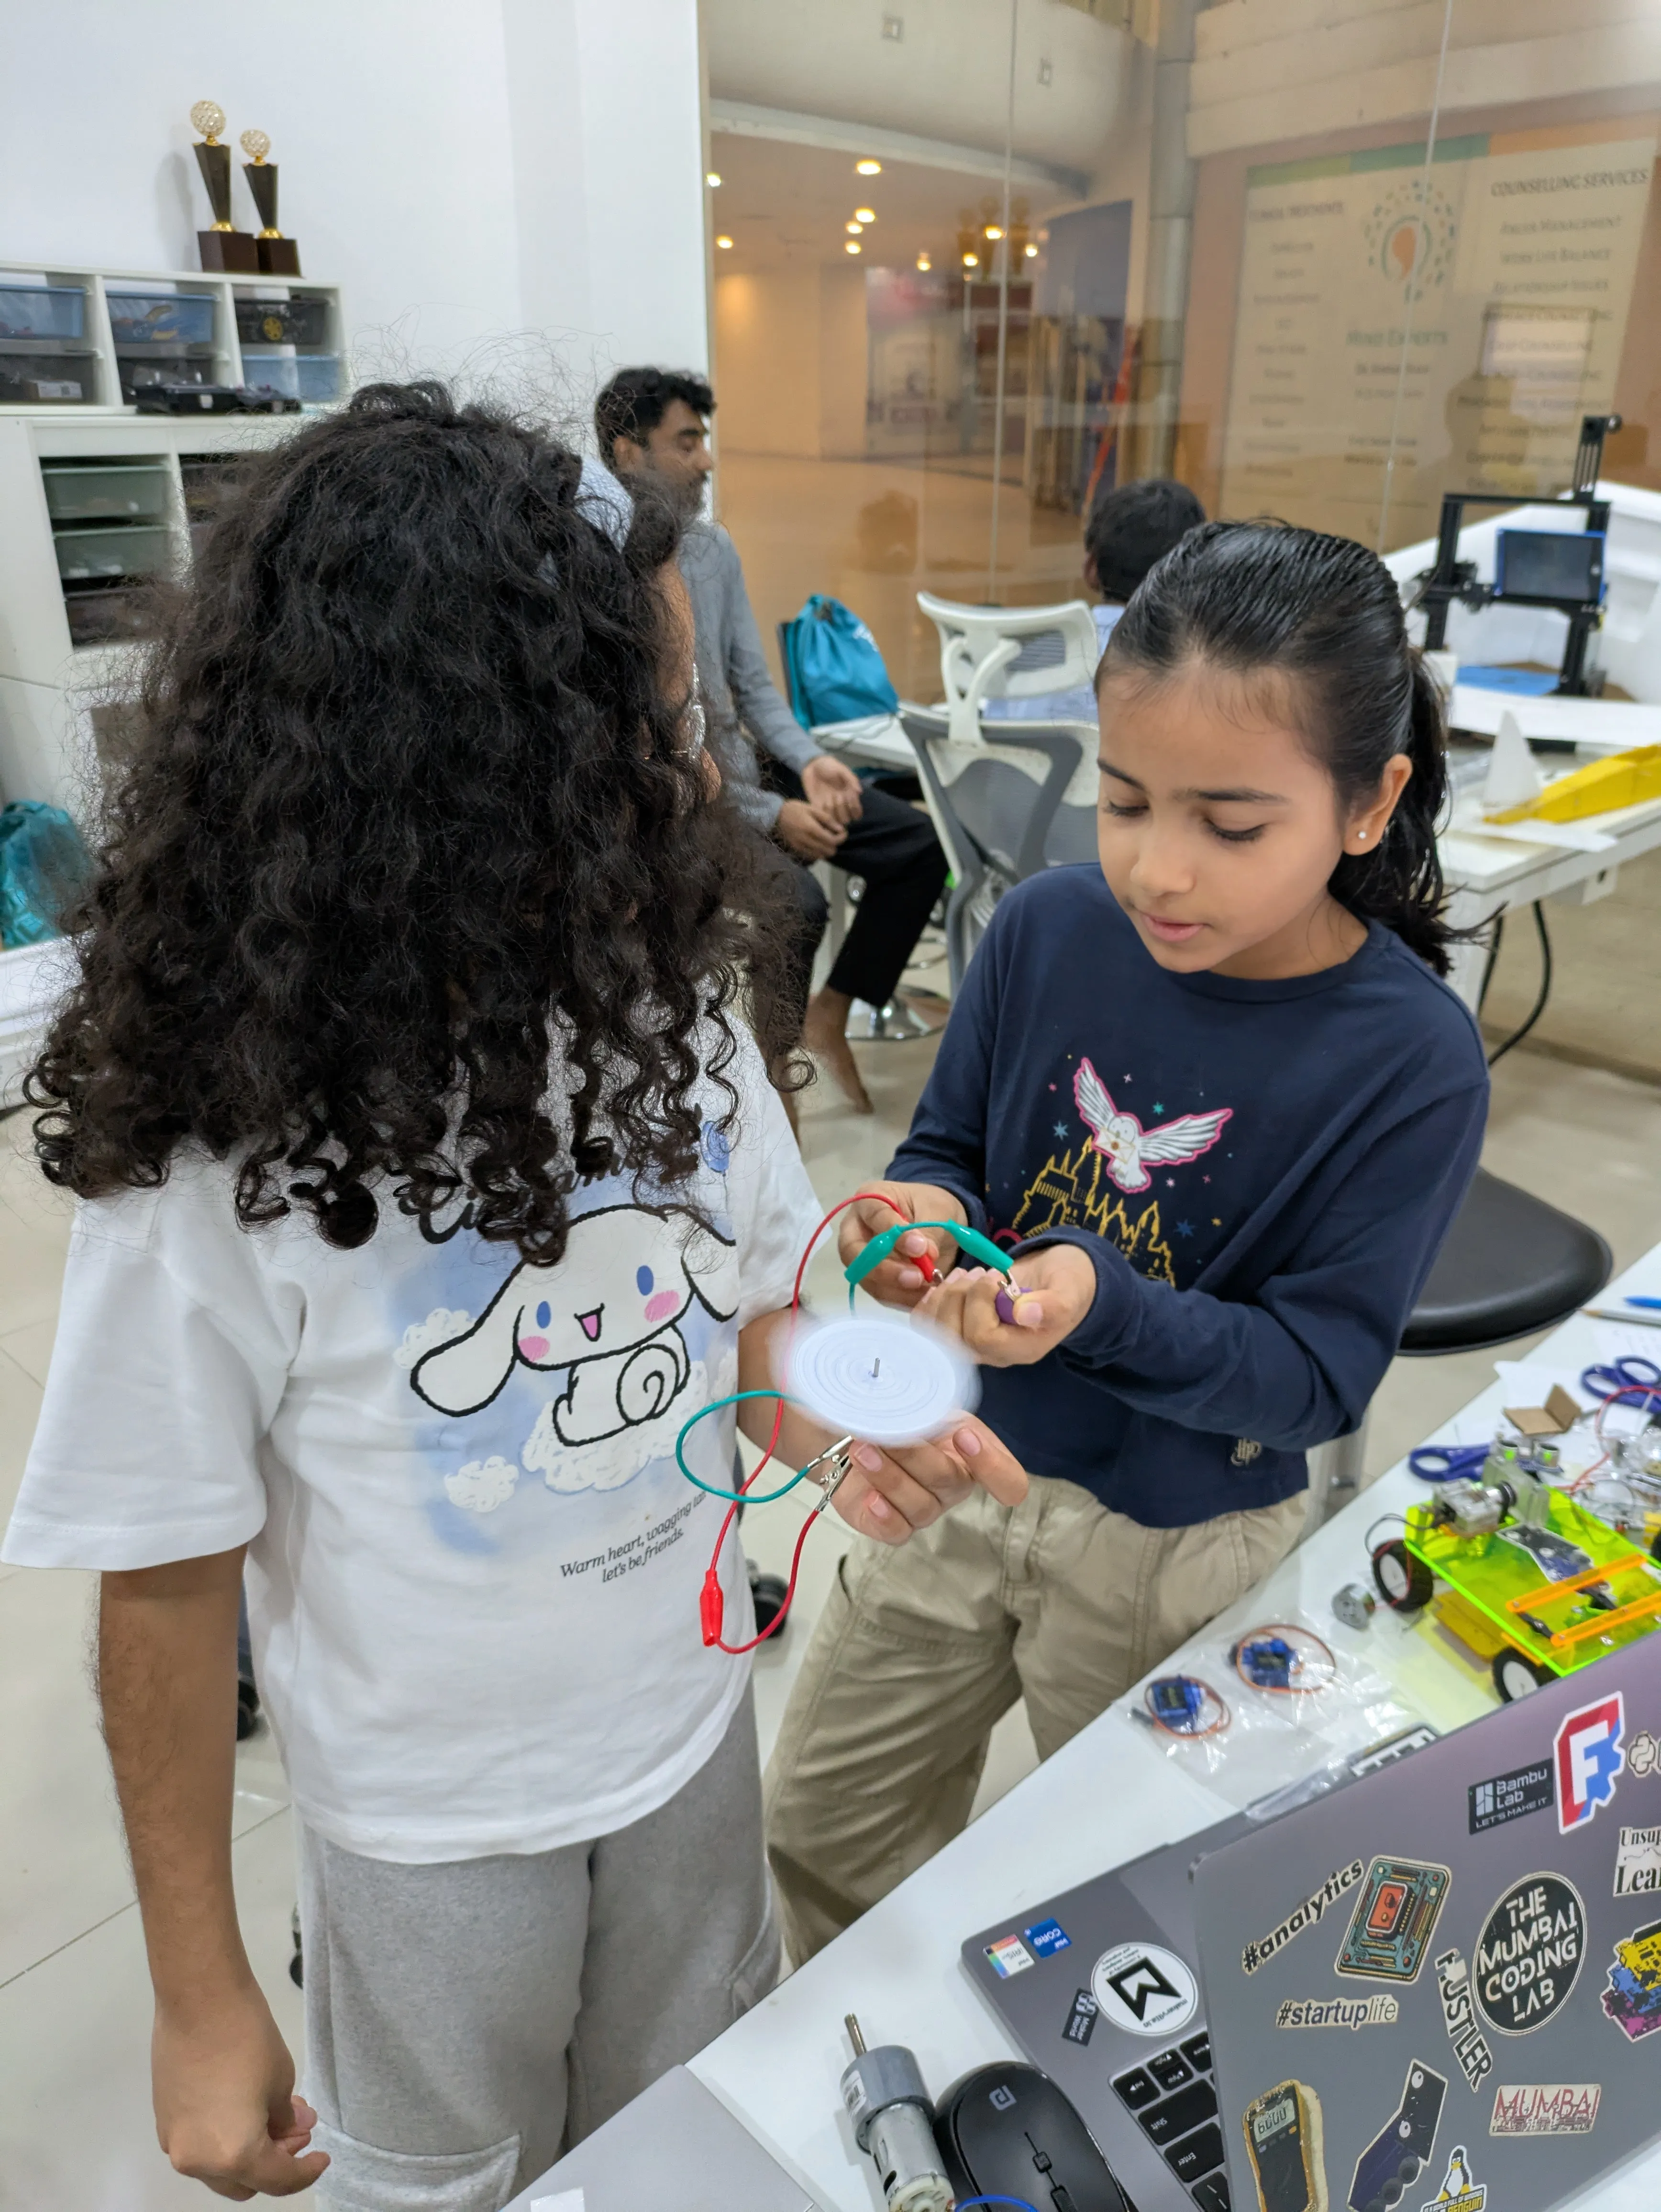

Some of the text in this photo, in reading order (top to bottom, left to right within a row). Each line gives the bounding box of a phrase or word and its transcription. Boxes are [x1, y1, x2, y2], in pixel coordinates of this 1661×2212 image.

[1491, 169, 1648, 197] COUNSELLING SERVICES
[560, 1554, 605, 1578] Warm
[608, 1535, 645, 1562] heart,
[646, 1502, 692, 1542] wagging
[602, 1562, 626, 1583] let's
[628, 1556, 642, 1571] be
[1496, 1768, 1548, 1795] Bambu
[1496, 1790, 1524, 1810] Lab
[1507, 1800, 1537, 1817] MAKE
[1538, 1796, 1548, 1806] IT
[1616, 1865, 1661, 1893] Lea
[1244, 1861, 1362, 1972] #analytics
[1506, 1886, 1546, 1927] THE
[1479, 1902, 1578, 1976] MUMBAI
[1485, 1933, 1577, 2002] CODING
[1278, 1998, 1396, 2028] #startuplife
[1512, 1978, 1555, 2023] LAB
[1494, 2088, 1599, 2120] MUMBAI
[1178, 2152, 1196, 2166] Enter
